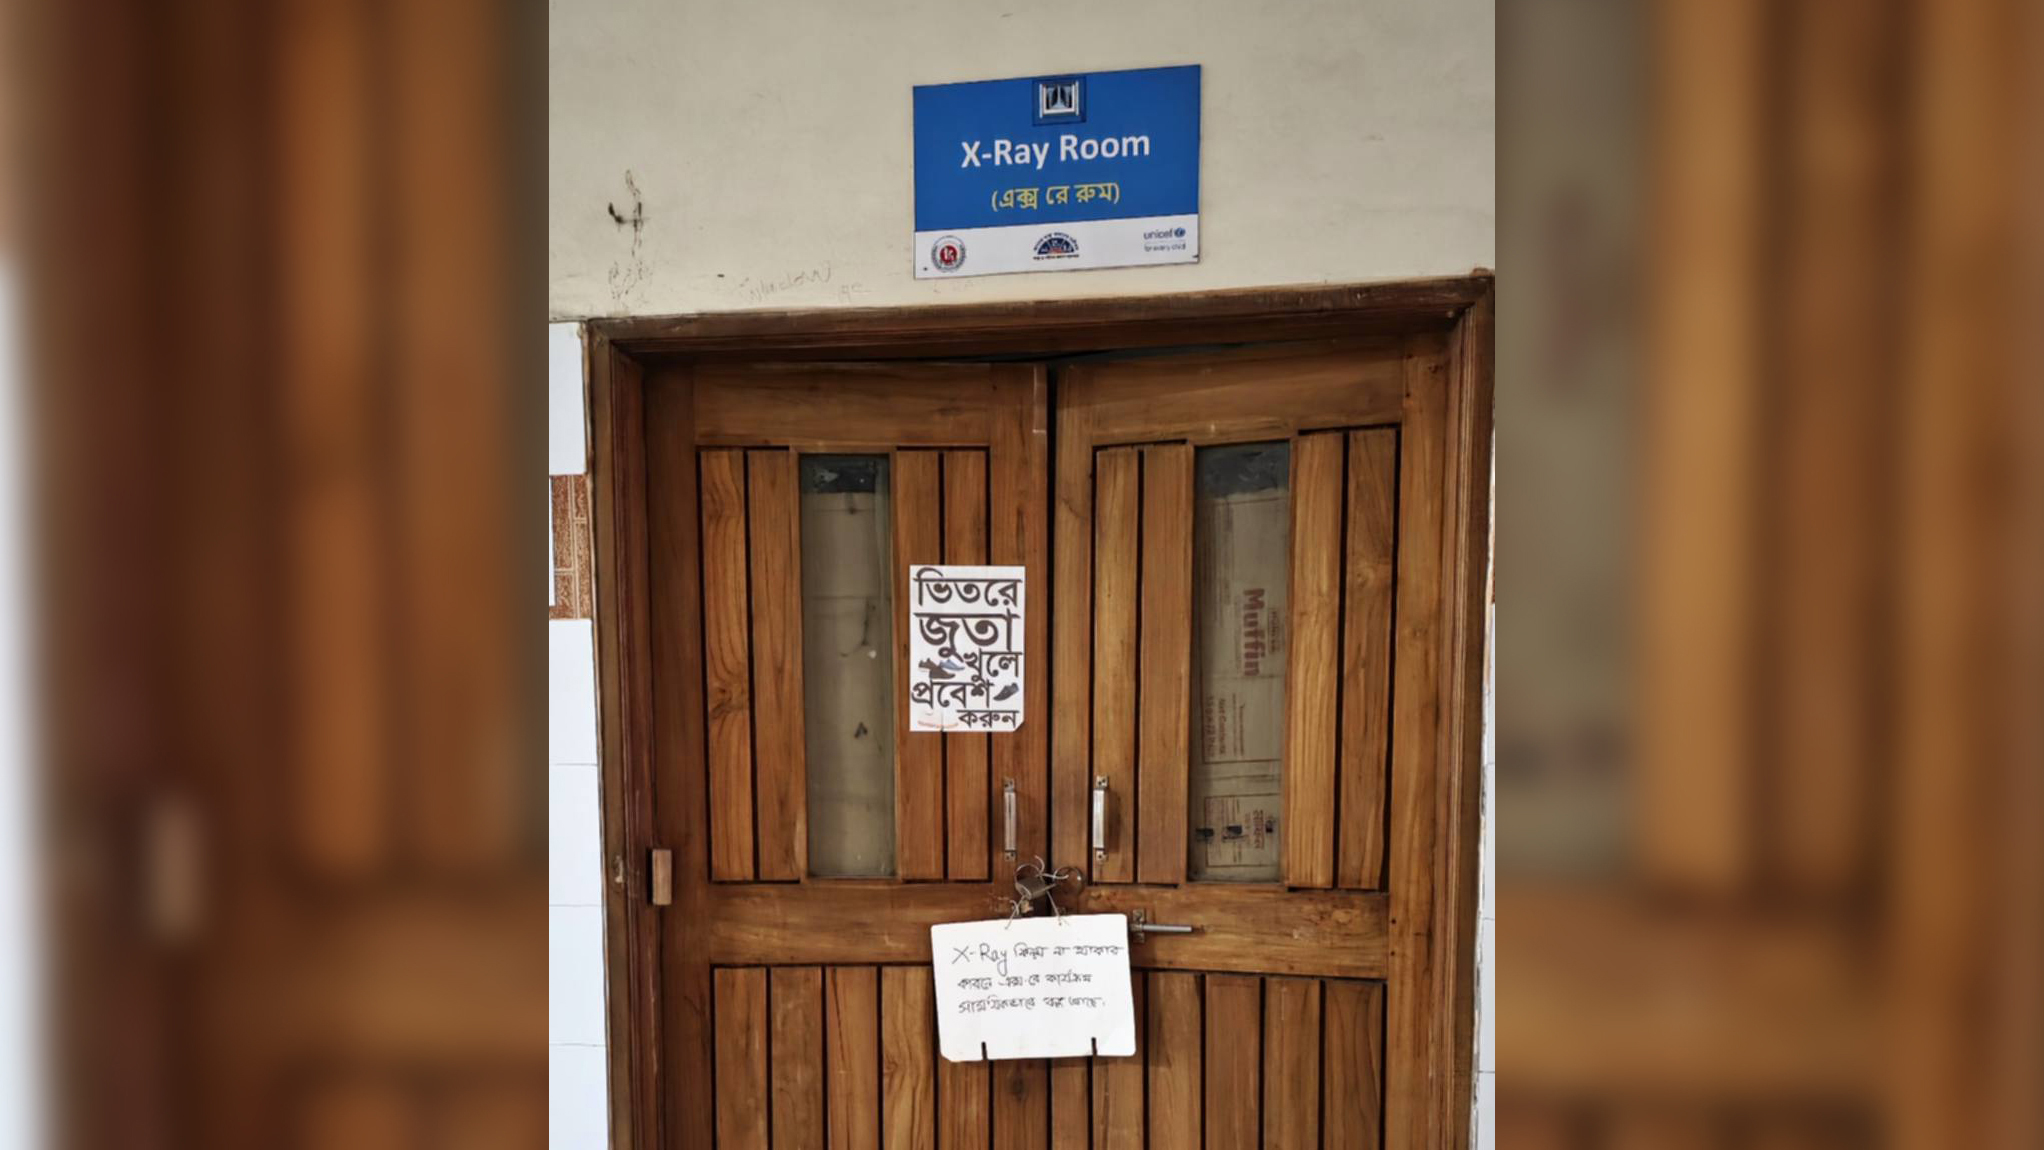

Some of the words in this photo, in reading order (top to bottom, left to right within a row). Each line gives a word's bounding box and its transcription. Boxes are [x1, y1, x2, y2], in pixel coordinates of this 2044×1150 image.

[961, 139, 1049, 170] X-Ray
[1060, 134, 1150, 162] Room
[991, 187, 1039, 212] (এক্স
[1046, 185, 1070, 204] রে
[1073, 182, 1120, 204] রুম)
[1143, 228, 1173, 240] unicef
[912, 567, 1023, 607] ভিতরে
[913, 608, 1021, 663] জুতা
[1243, 588, 1265, 676] Muffin
[963, 648, 1023, 683] খুলে
[911, 679, 994, 708] প্রবেশ
[956, 709, 1020, 728] করুন
[952, 942, 1008, 977] X-Ray
